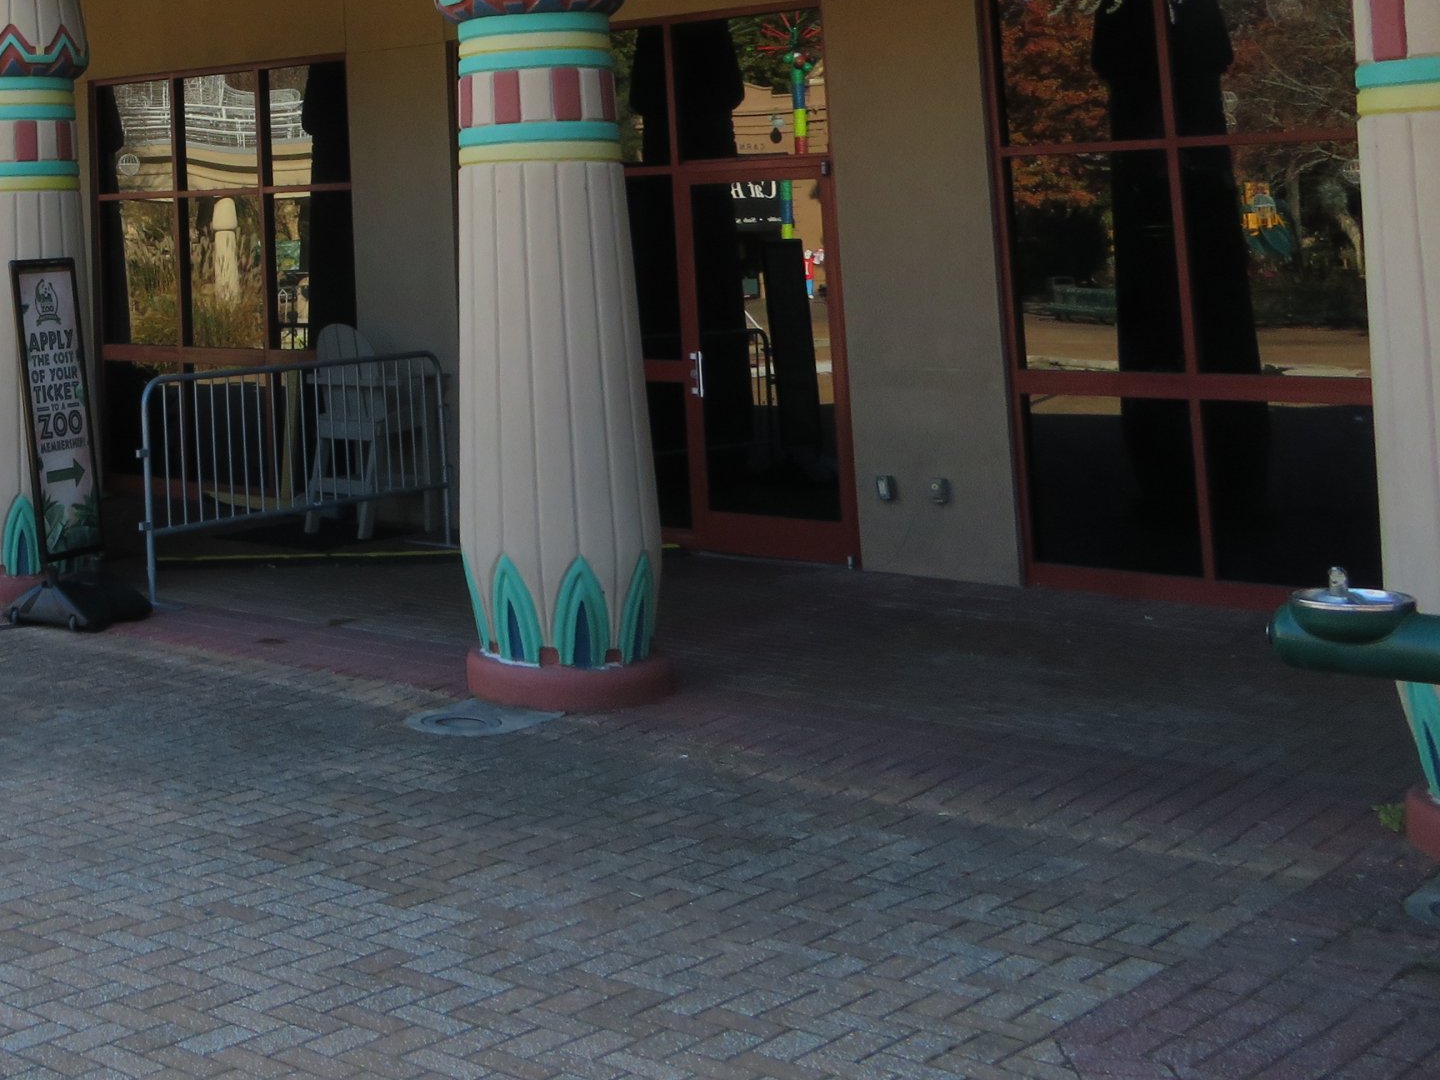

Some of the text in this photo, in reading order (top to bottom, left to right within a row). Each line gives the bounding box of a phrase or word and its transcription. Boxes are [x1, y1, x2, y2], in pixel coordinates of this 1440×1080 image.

[29, 329, 73, 352] APPLY
[32, 351, 74, 367] THE COST
[31, 365, 78, 383] OF YOUR
[33, 381, 79, 404] TICKET
[51, 403, 59, 411] TO
[38, 410, 82, 439] ZOO
